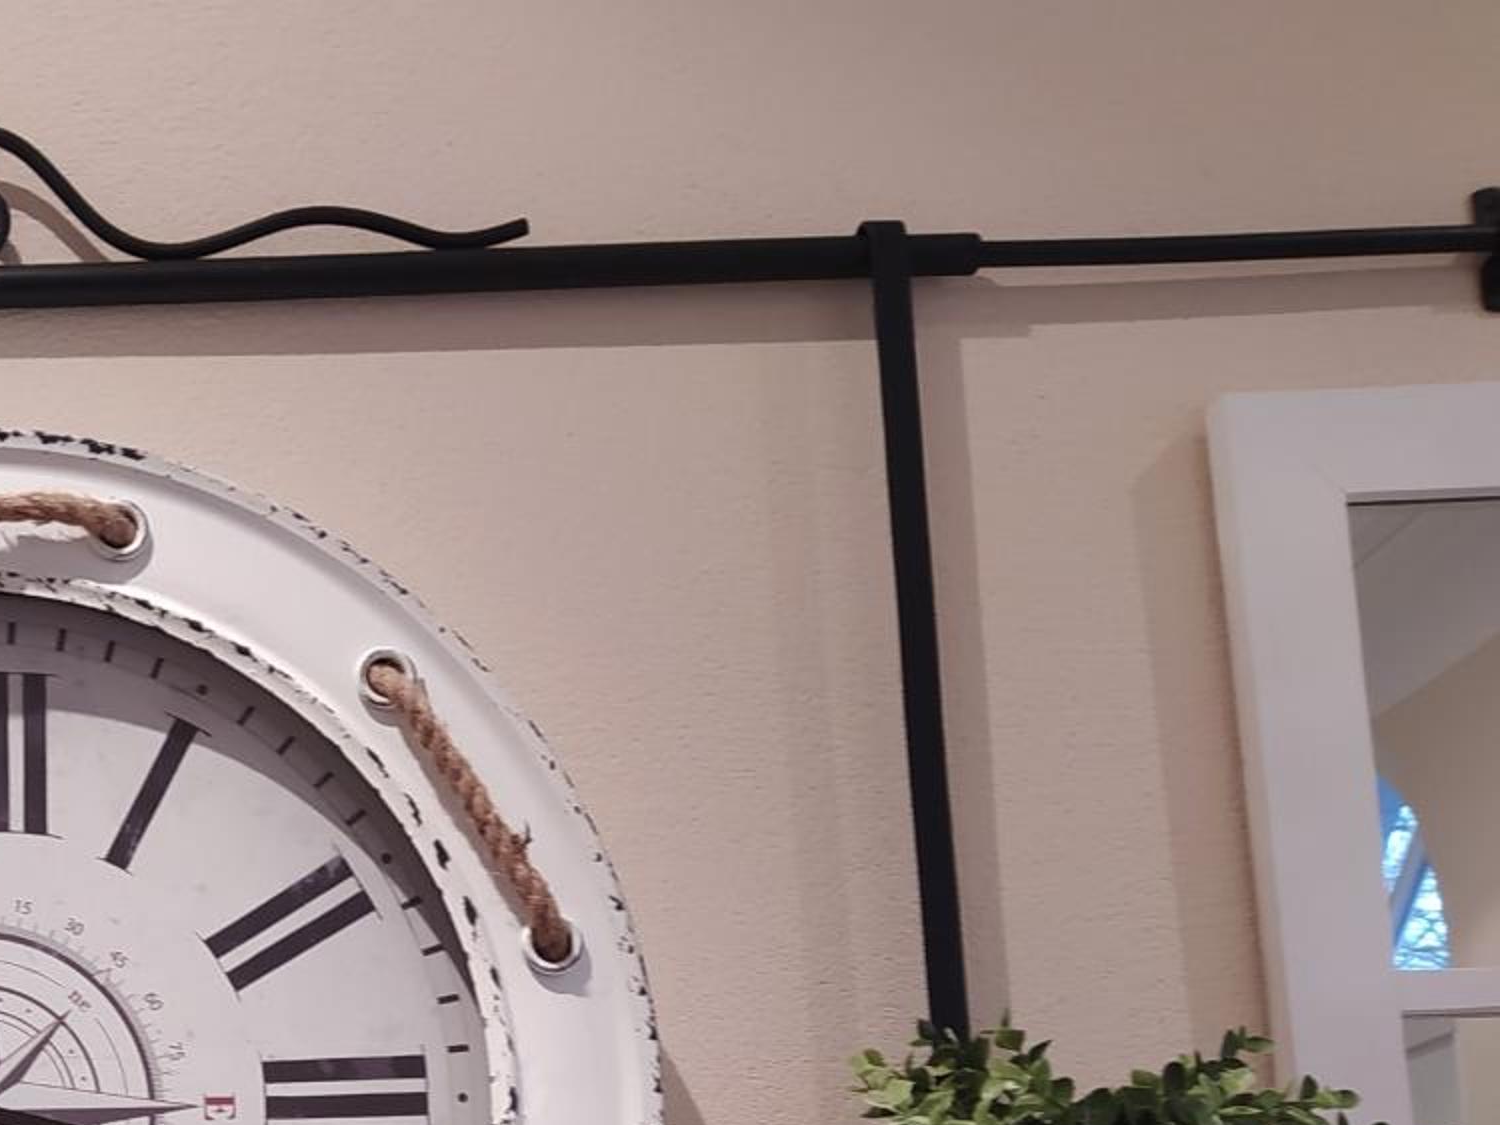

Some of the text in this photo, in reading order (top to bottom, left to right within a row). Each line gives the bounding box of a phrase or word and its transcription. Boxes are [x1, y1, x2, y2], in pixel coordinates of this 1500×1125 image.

[96, 711, 212, 876] I
[13, 899, 33, 916] 15
[63, 917, 85, 936] 30
[195, 842, 383, 1001] II
[110, 950, 129, 970] 45
[144, 991, 165, 1012] 60
[167, 1041, 186, 1062] 75
[203, 1094, 237, 1121] E
